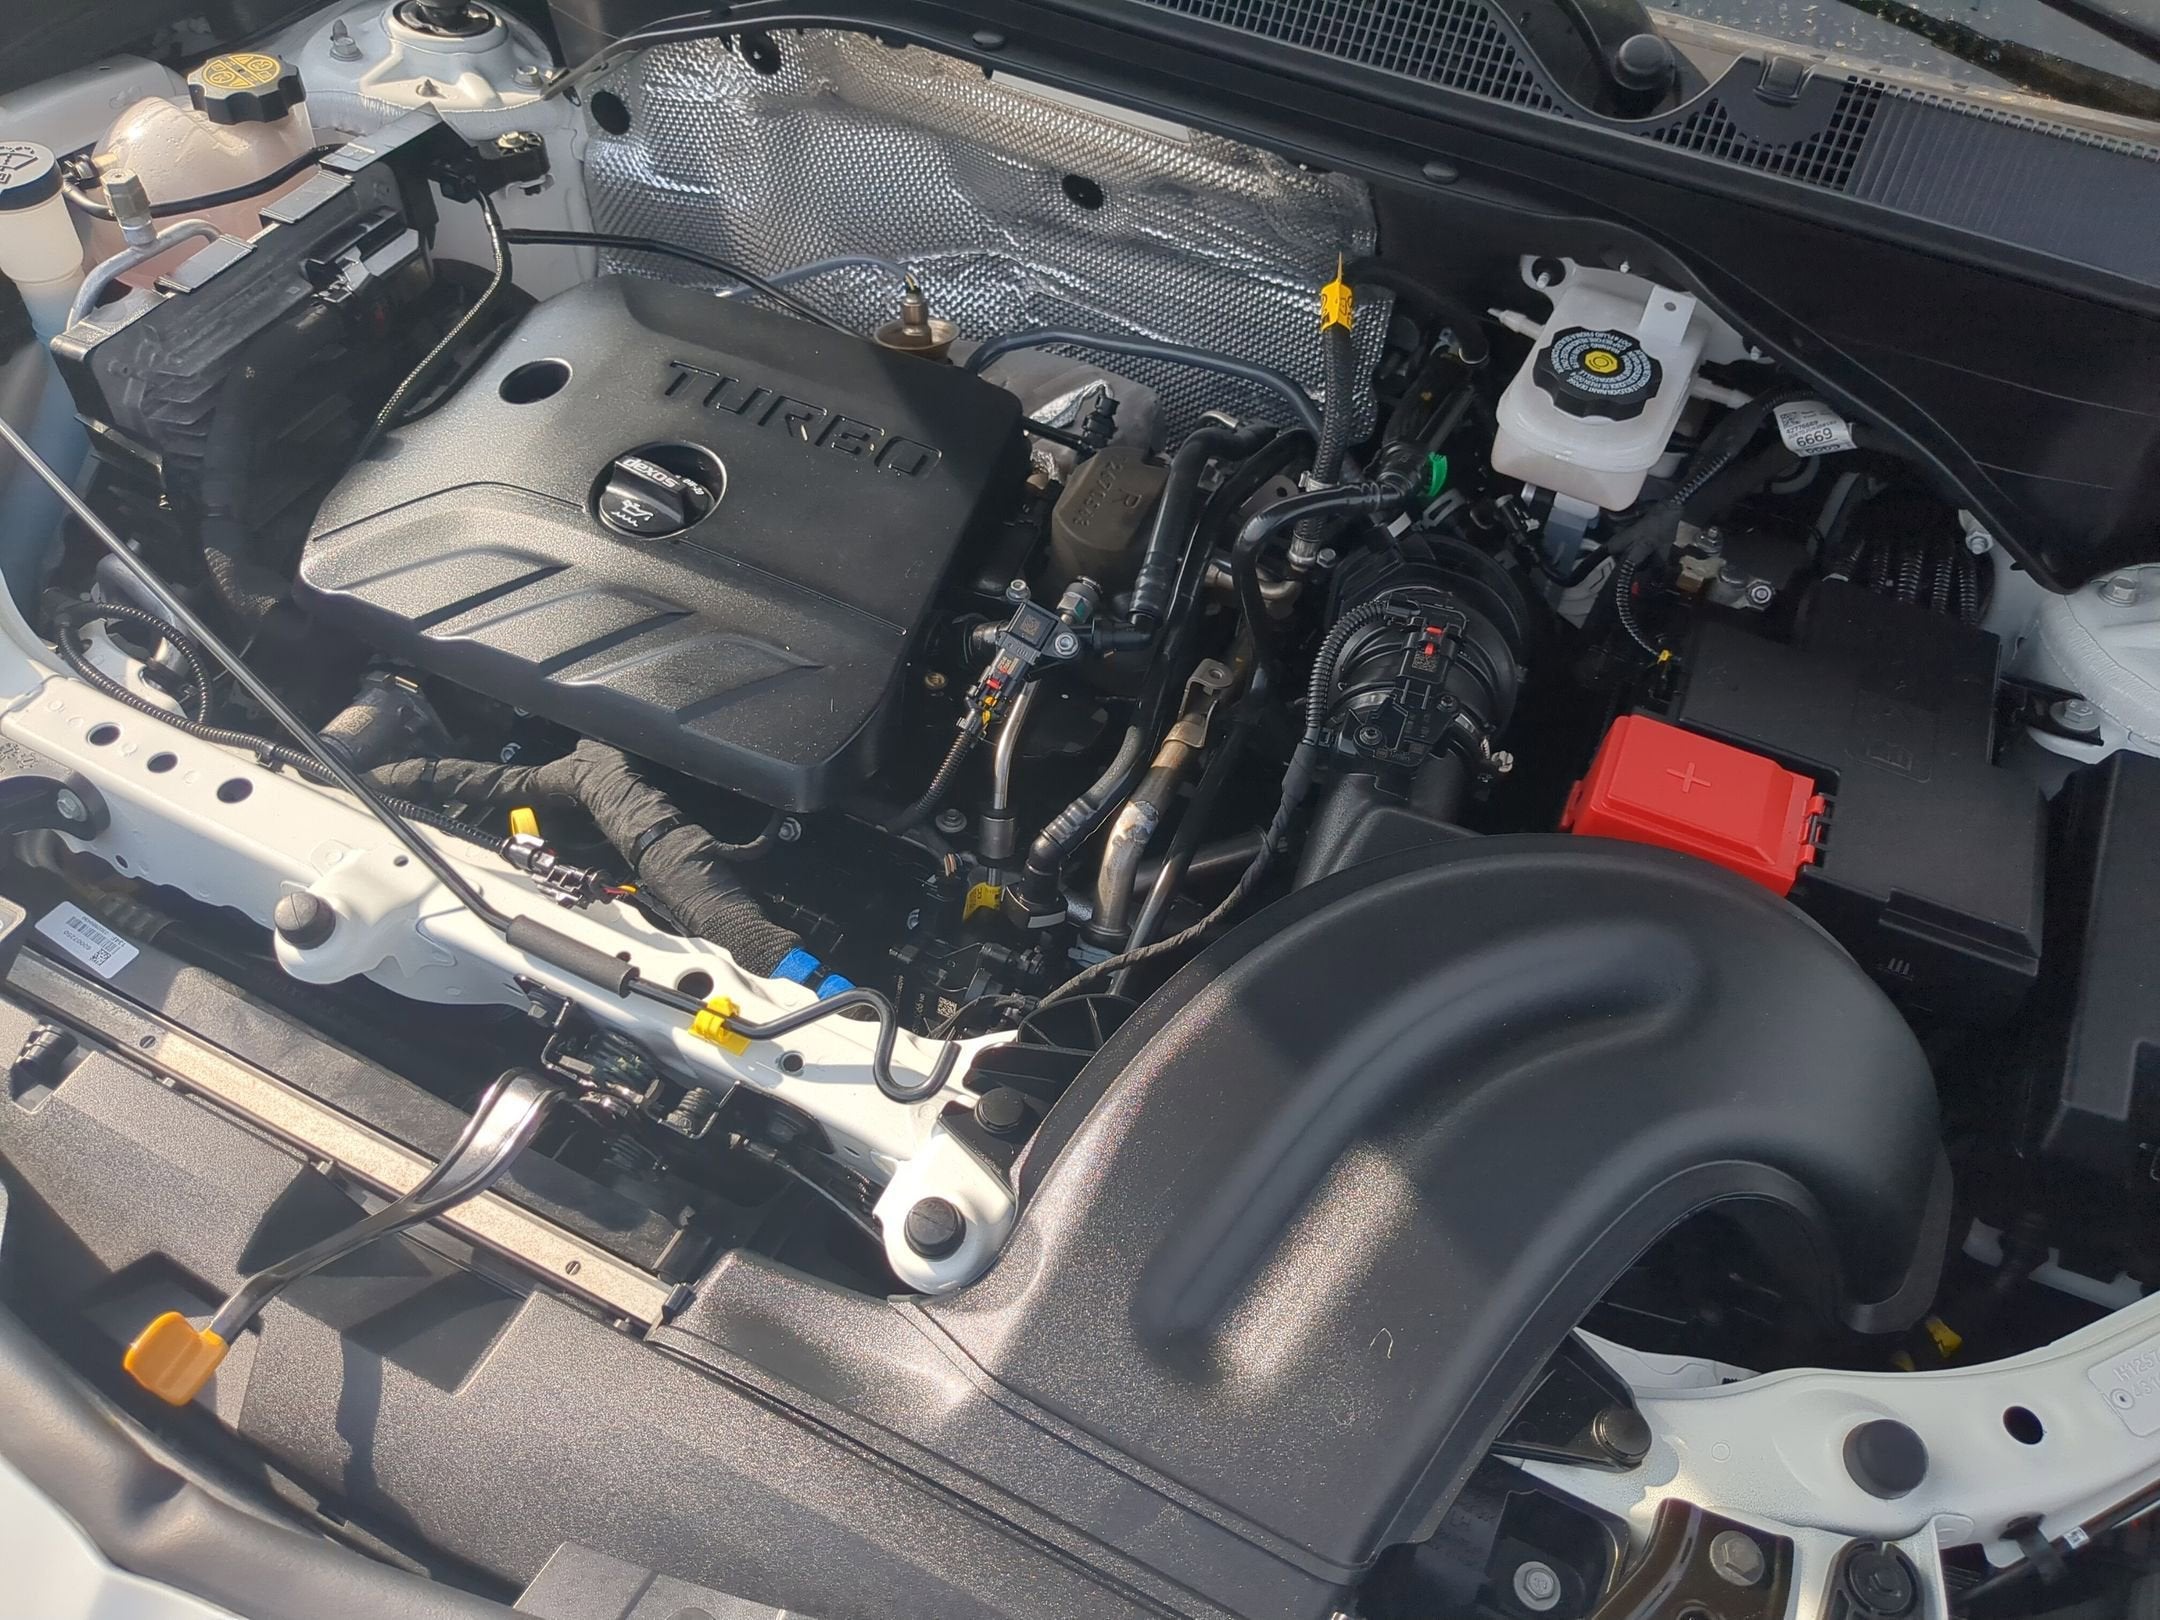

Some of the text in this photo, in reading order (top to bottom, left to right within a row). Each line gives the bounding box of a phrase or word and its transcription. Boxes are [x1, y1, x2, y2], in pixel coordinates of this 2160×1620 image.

[664, 360, 942, 478] TURBO
[1796, 427, 1833, 447] 6669
[622, 457, 680, 488] dexos
